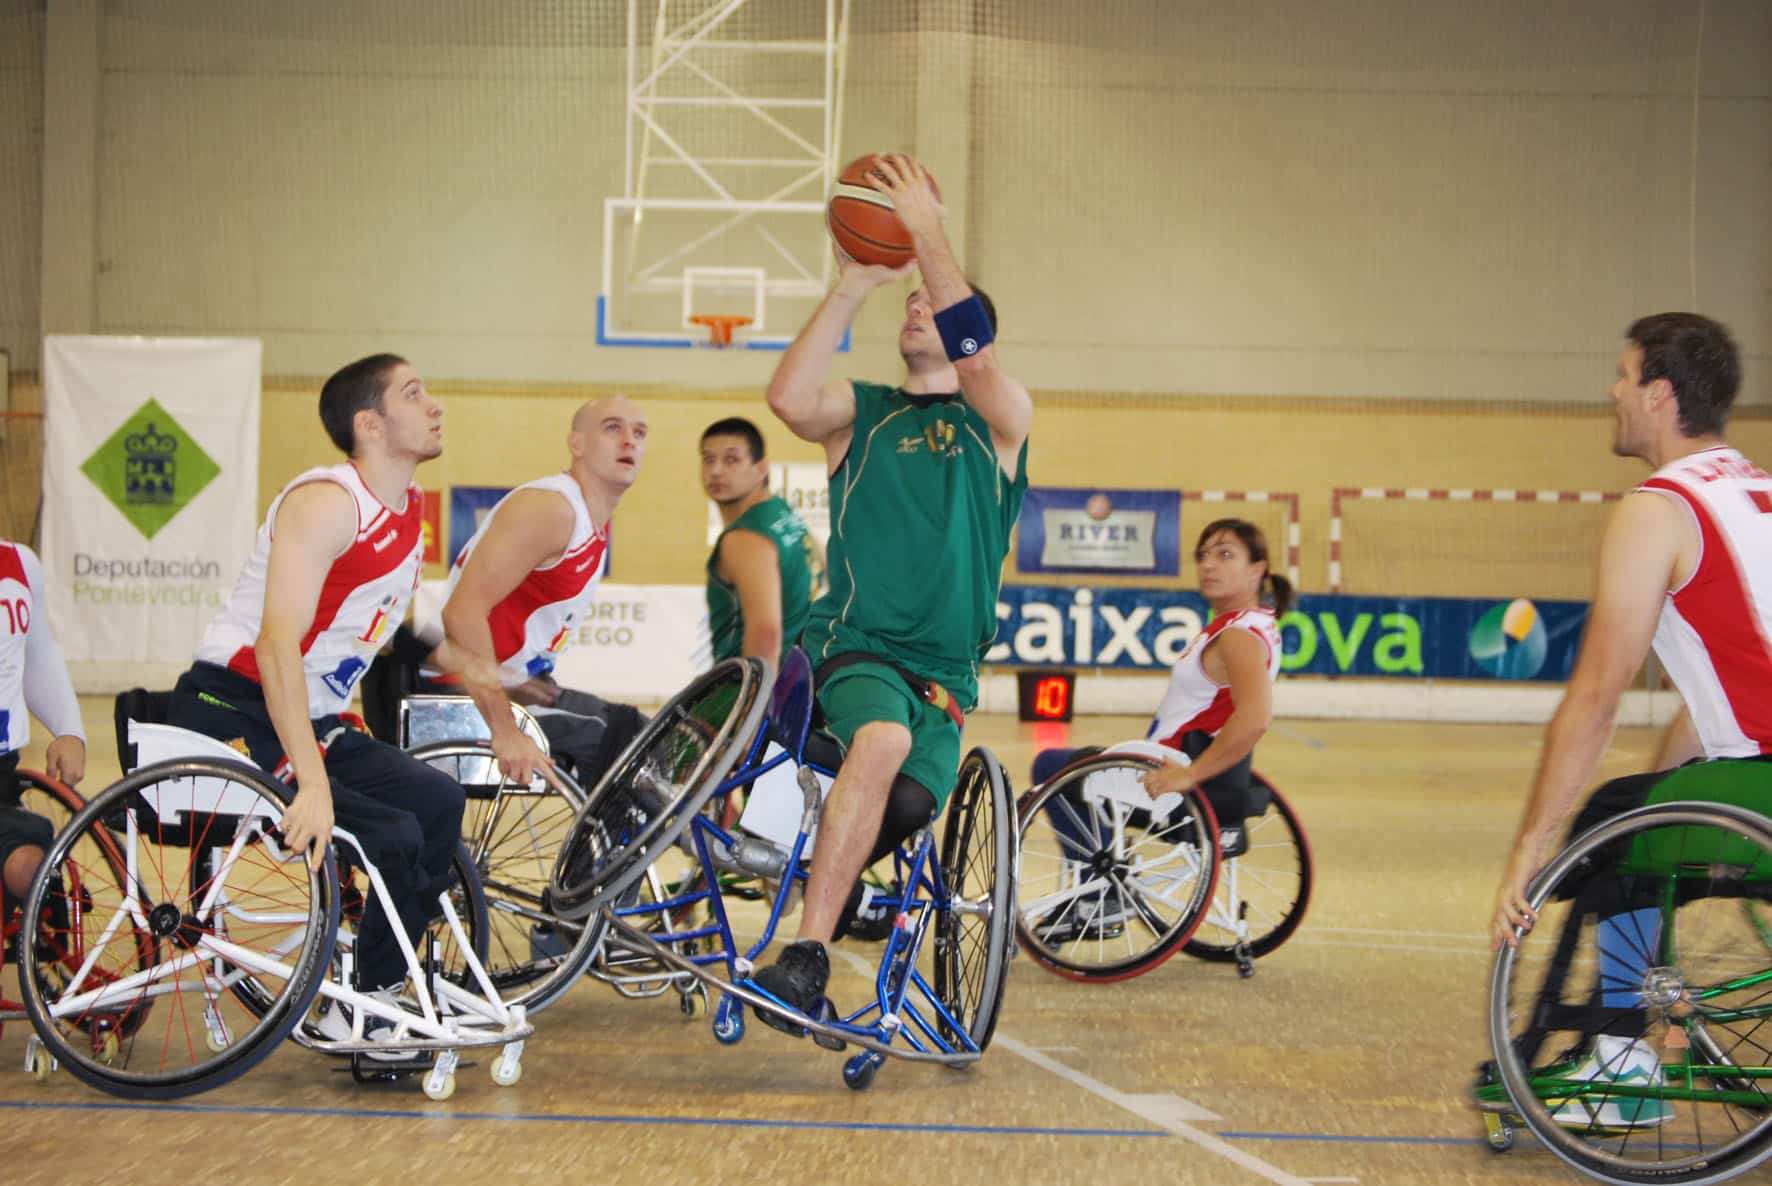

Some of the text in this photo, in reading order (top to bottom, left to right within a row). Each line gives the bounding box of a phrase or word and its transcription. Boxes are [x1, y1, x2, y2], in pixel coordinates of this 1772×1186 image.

[1060, 523, 1138, 541] RIVER
[73, 553, 220, 582] Deputación
[0, 598, 30, 635] 10
[574, 627, 634, 646] EGO
[1035, 676, 1068, 717] 10
